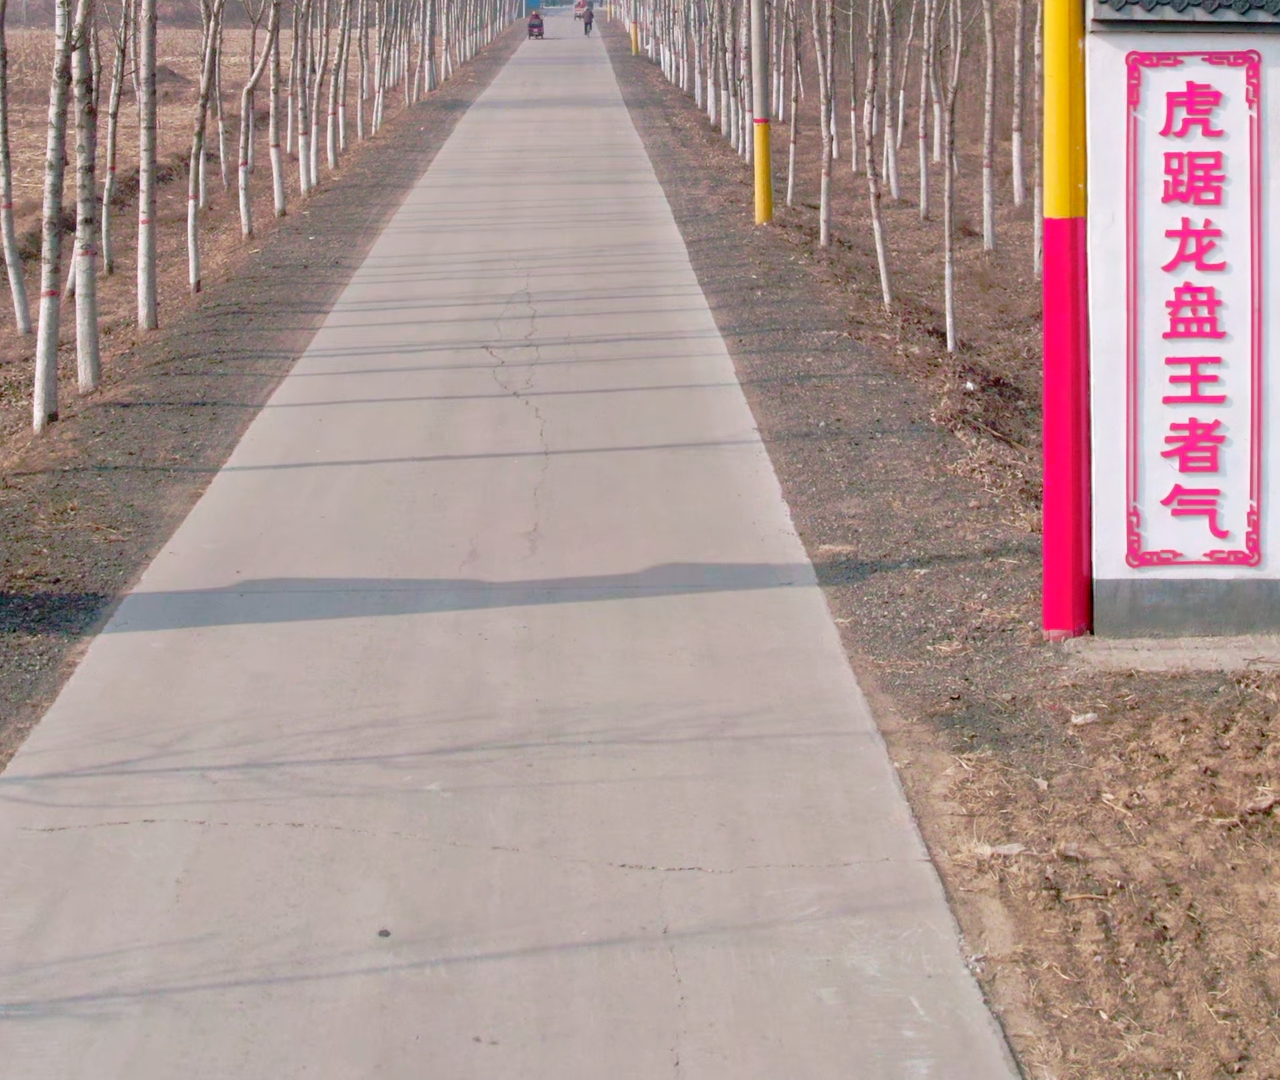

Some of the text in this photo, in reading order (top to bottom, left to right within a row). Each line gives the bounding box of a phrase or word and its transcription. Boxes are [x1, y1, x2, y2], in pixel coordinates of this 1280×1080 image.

[1159, 80, 1230, 539] 虎踞龙盘王者气
